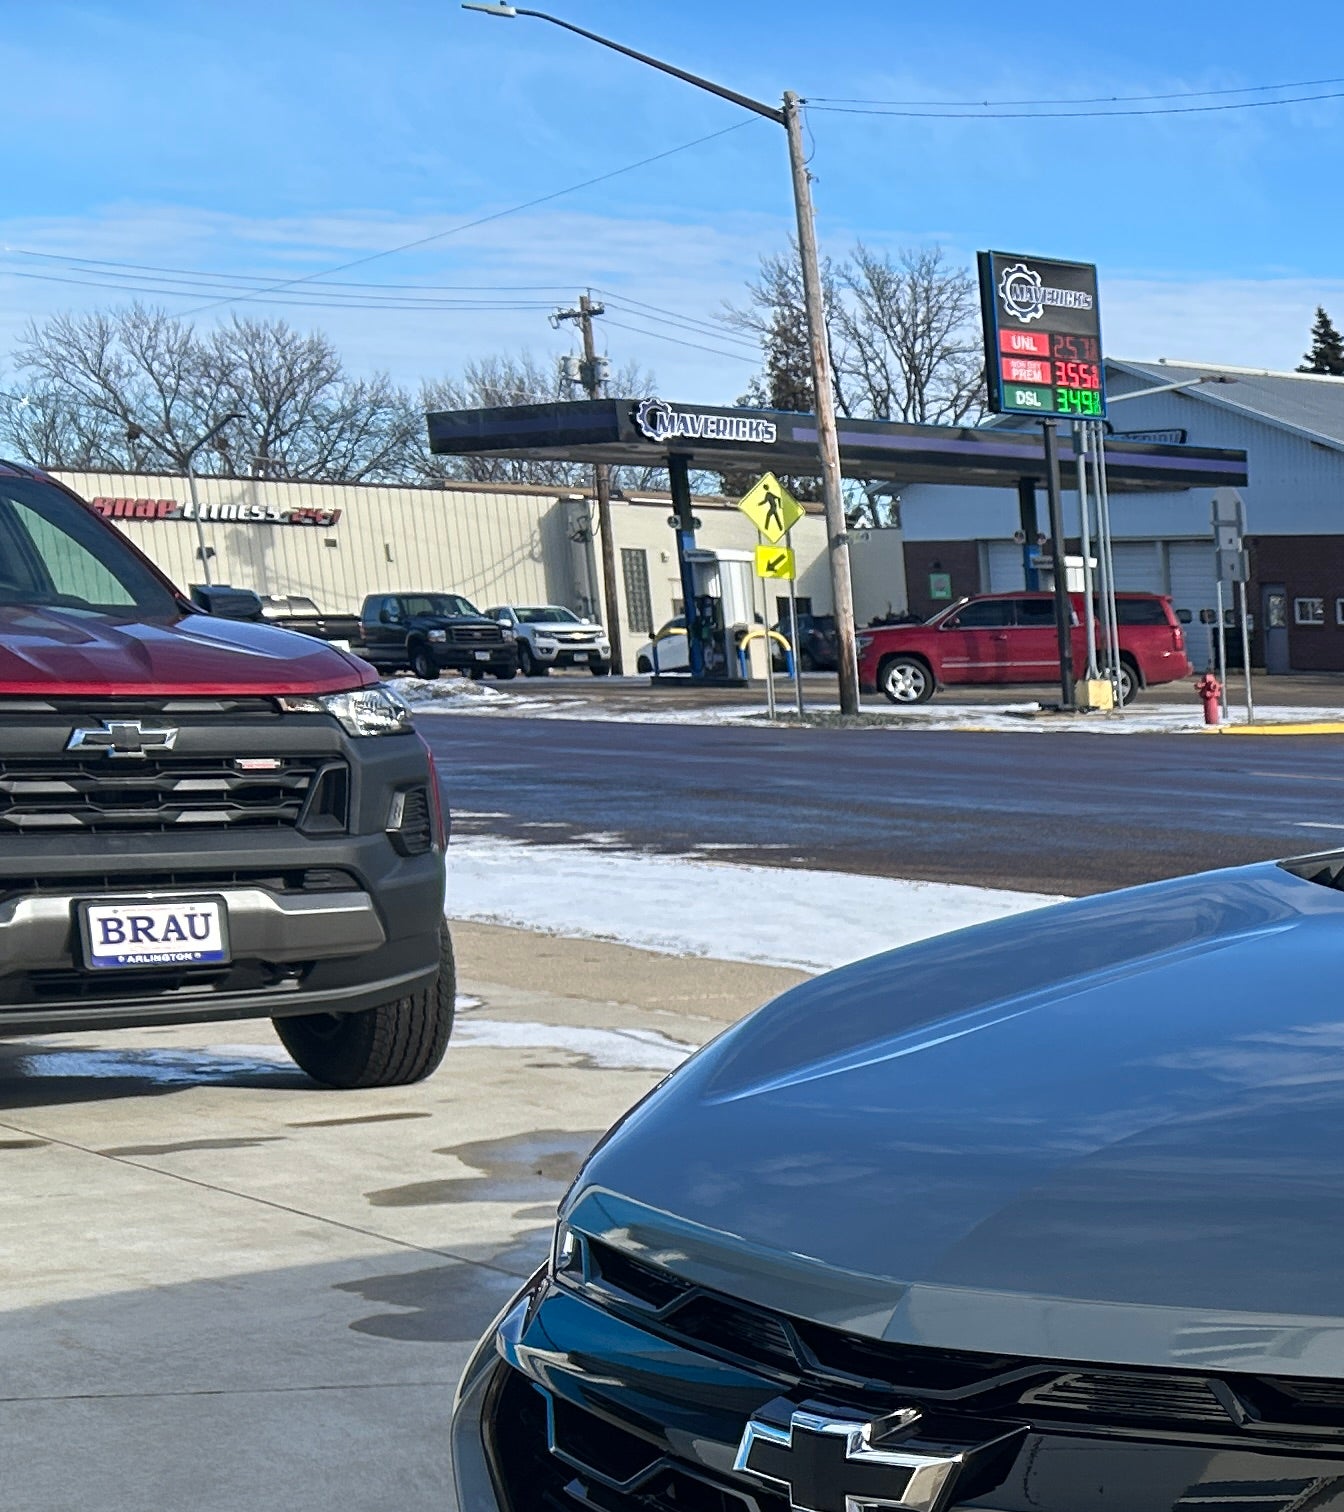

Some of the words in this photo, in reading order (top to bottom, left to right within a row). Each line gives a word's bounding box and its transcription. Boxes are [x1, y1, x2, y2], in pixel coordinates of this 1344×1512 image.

[1012, 335, 1038, 351] UNL
[1012, 369, 1042, 383] PREM
[1016, 391, 1041, 407] DSL
[656, 411, 776, 444] MAVERICK'S
[97, 912, 212, 945] BRAU
[126, 952, 194, 964] ARLINGTON
